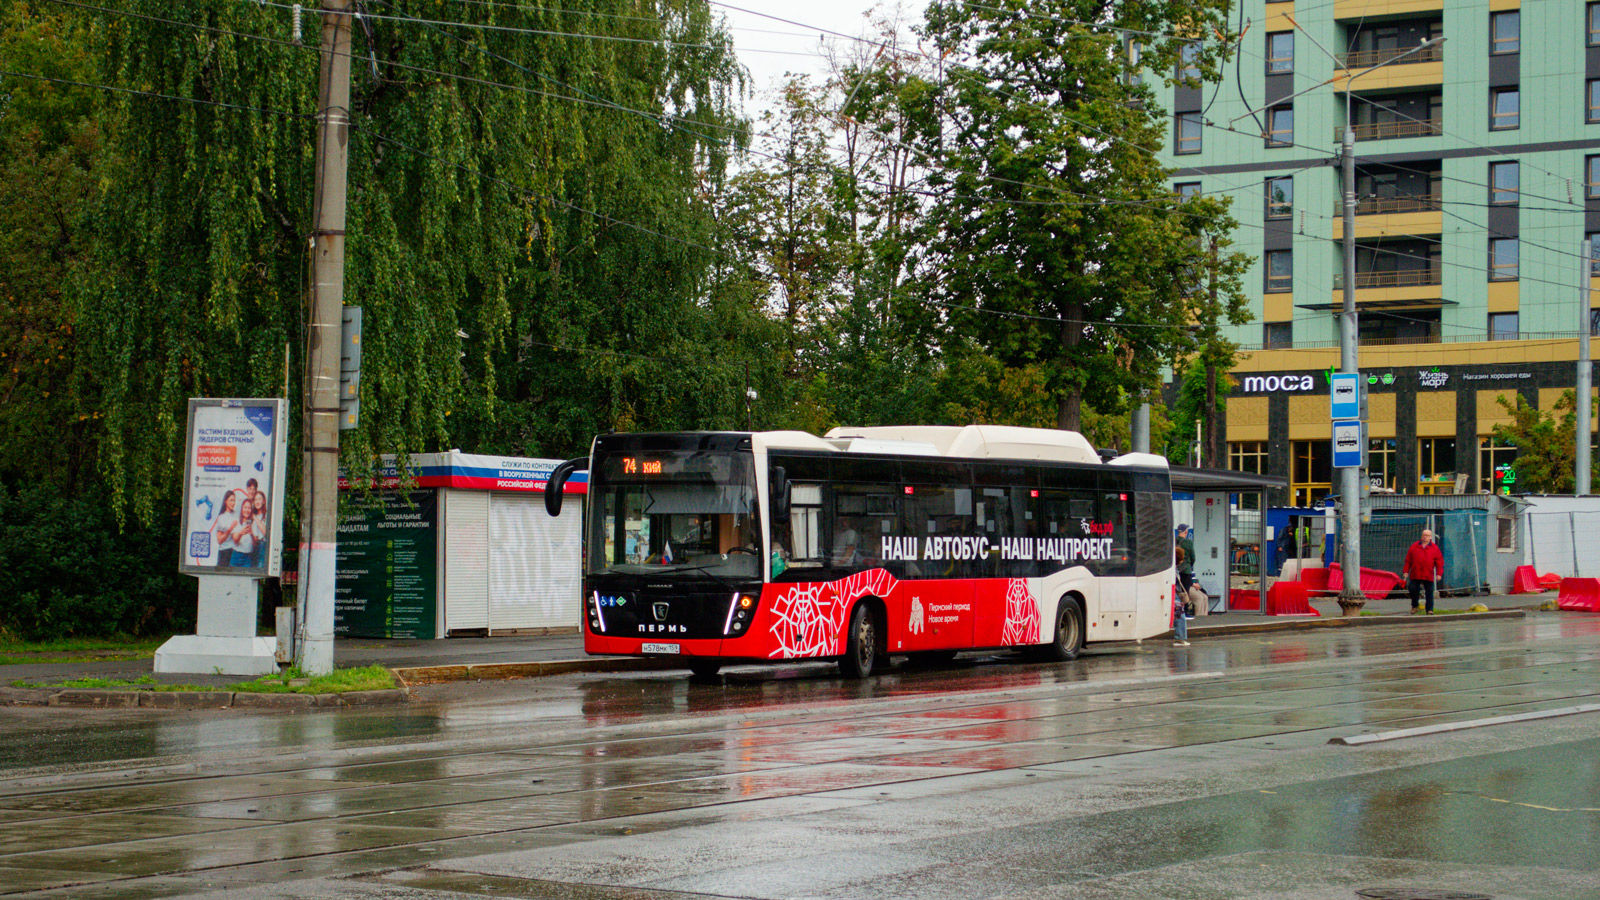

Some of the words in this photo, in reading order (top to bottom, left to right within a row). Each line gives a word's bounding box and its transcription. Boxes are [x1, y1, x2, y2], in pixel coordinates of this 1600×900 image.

[1490, 372, 1517, 380] хорошей
[1421, 379, 1447, 388] март
[623, 457, 637, 474] 74
[504, 471, 545, 479] ВООРУЖЕННЫХ
[1503, 470, 1516, 480] 20
[497, 480, 533, 488] РОССИЙСКОЙ
[1370, 478, 1382, 486] 20
[881, 536, 918, 561] НАШ
[923, 536, 989, 560] АВТОБУС
[1001, 537, 1033, 560] НАШ
[1036, 538, 1113, 565] НАЦПРОЕКТ
[928, 602, 953, 612] Пермский
[953, 602, 971, 613] период
[928, 615, 944, 623] Новое
[944, 615, 959, 624] время
[638, 624, 687, 632] ПЕРМЬ
